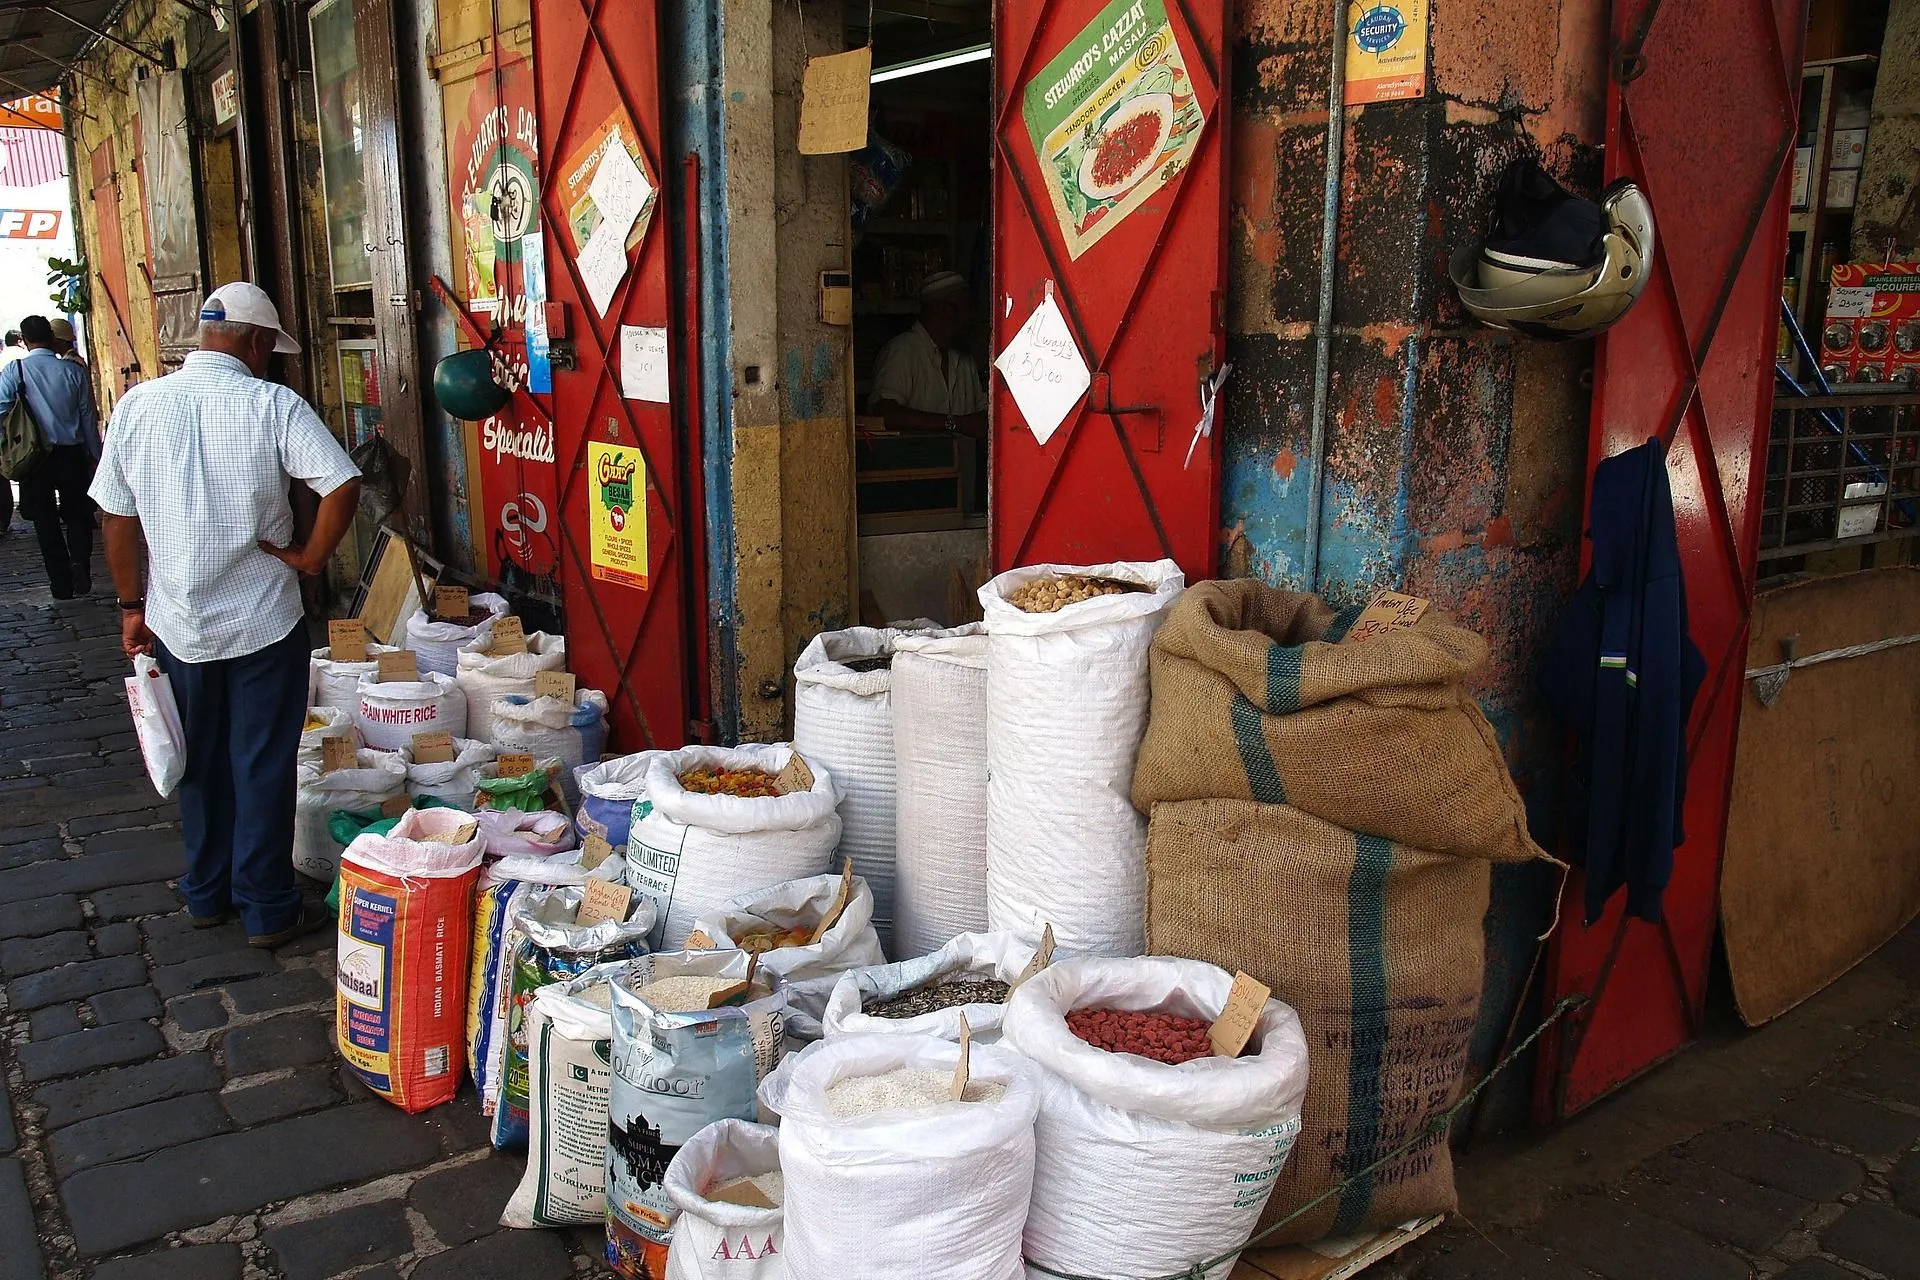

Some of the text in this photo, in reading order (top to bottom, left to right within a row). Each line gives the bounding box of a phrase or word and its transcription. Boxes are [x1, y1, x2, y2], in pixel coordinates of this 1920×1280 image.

[1360, 22, 1398, 37] SECURITY
[1044, 1, 1146, 110] STEWARD'S LAZZAT
[1064, 76, 1126, 136] TANDOORI CHICKEN
[608, 485, 631, 501] BESAN
[382, 709, 411, 725] WHITE
[414, 704, 437, 724] RICE
[644, 848, 677, 875] LIMITED.
[636, 871, 669, 894] TERRACE
[353, 896, 394, 915] SUPER KERNEL
[434, 916, 446, 1018] INDIAN BASMATI RICE
[628, 1138, 656, 1156] SUPER
[711, 1234, 778, 1260] AAA
